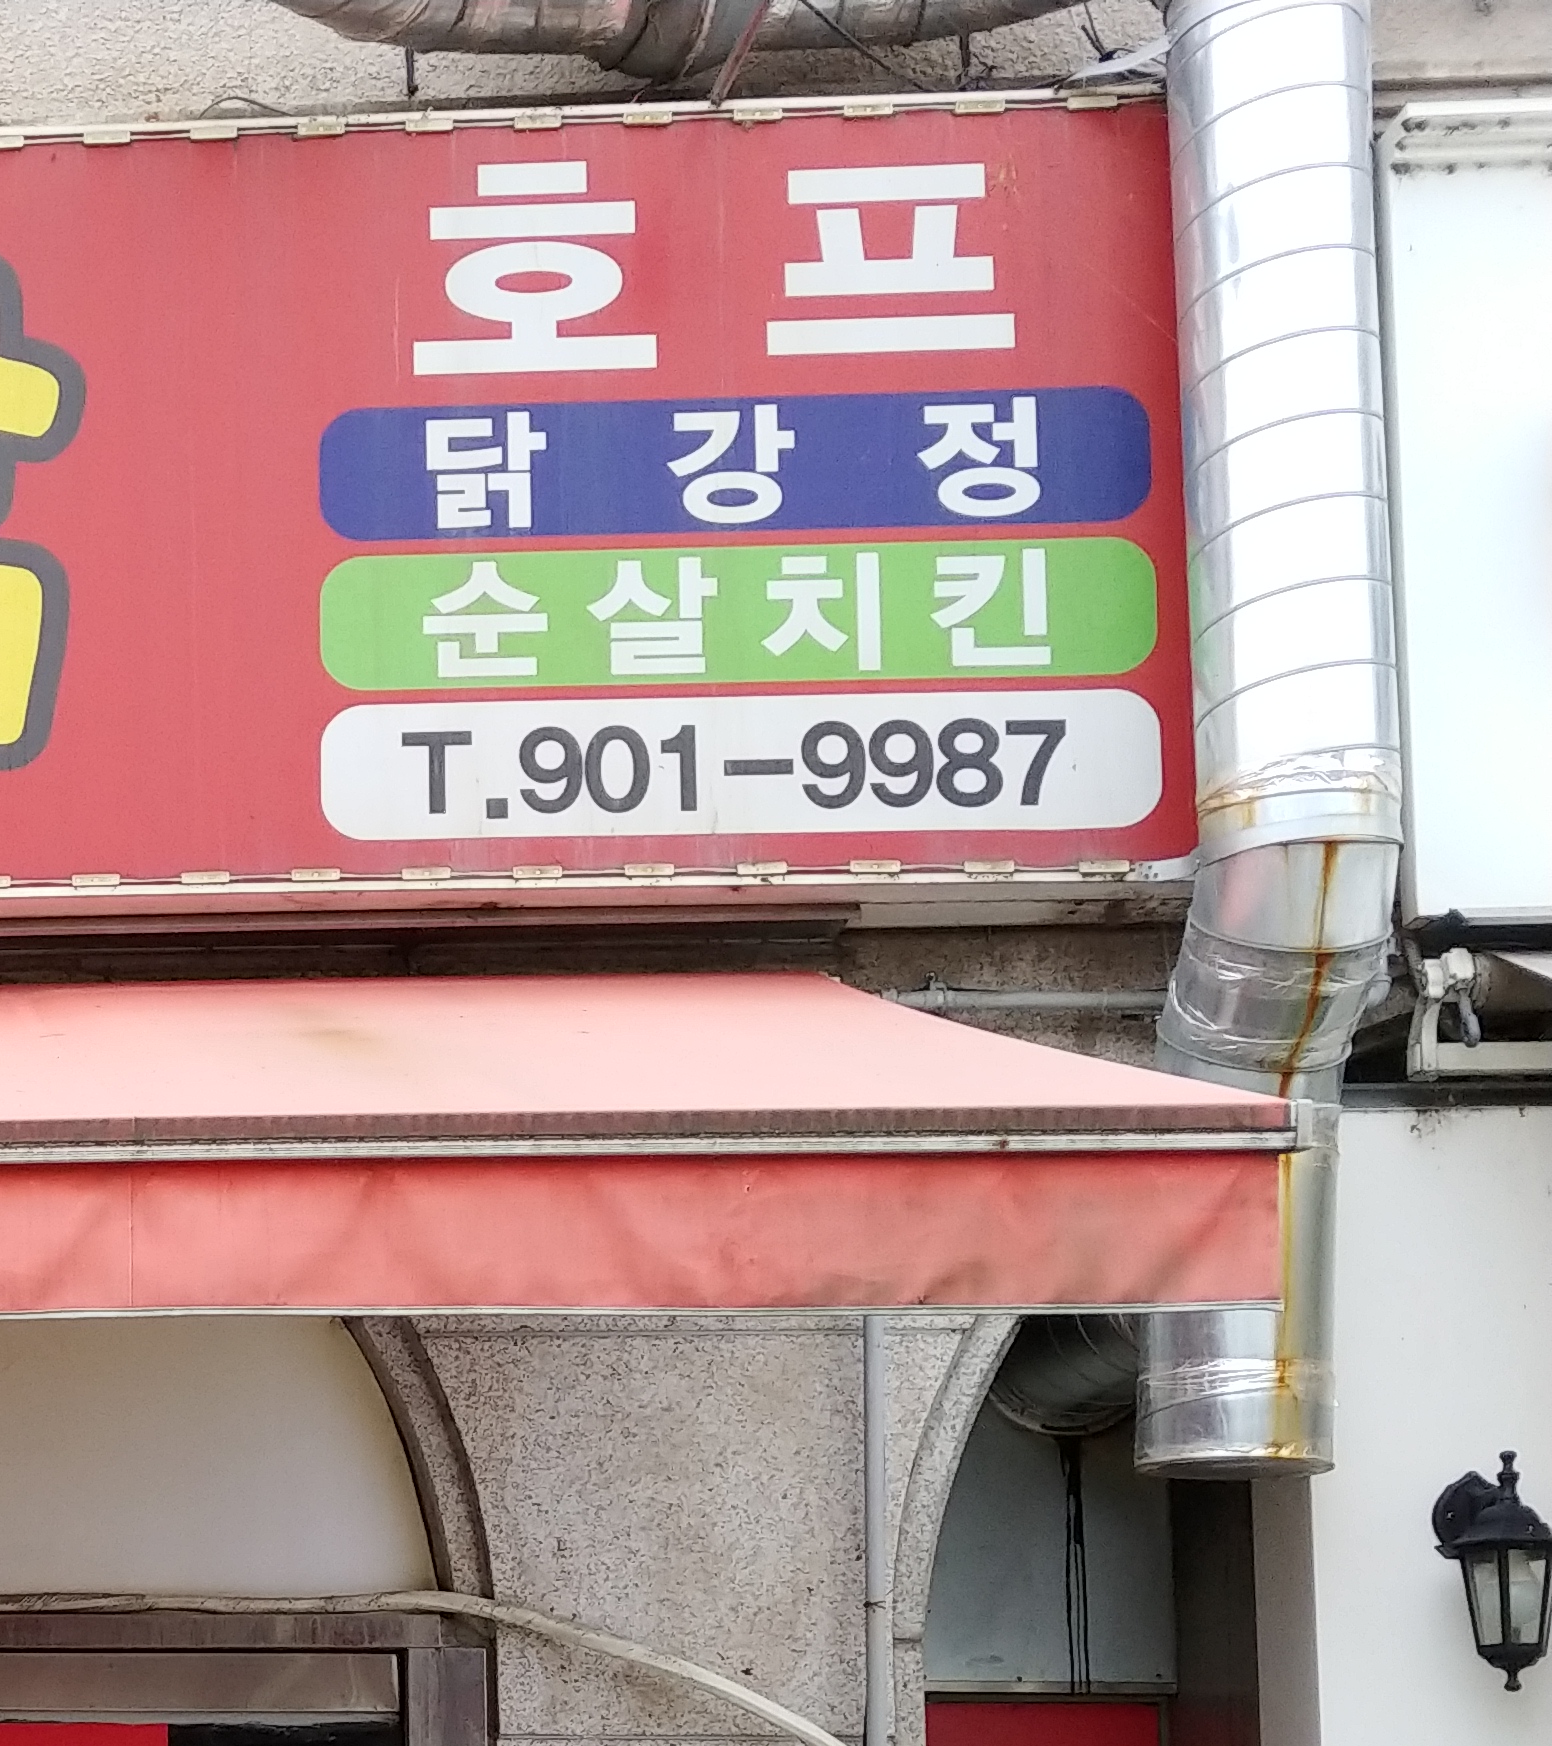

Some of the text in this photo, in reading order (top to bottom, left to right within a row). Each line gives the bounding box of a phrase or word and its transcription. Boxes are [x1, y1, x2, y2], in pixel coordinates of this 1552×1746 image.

[413, 162, 1015, 376] 호프
[423, 397, 1042, 527] 닭강정
[423, 551, 1055, 679] 순살치킨
[402, 719, 1067, 820] T.901-9987
